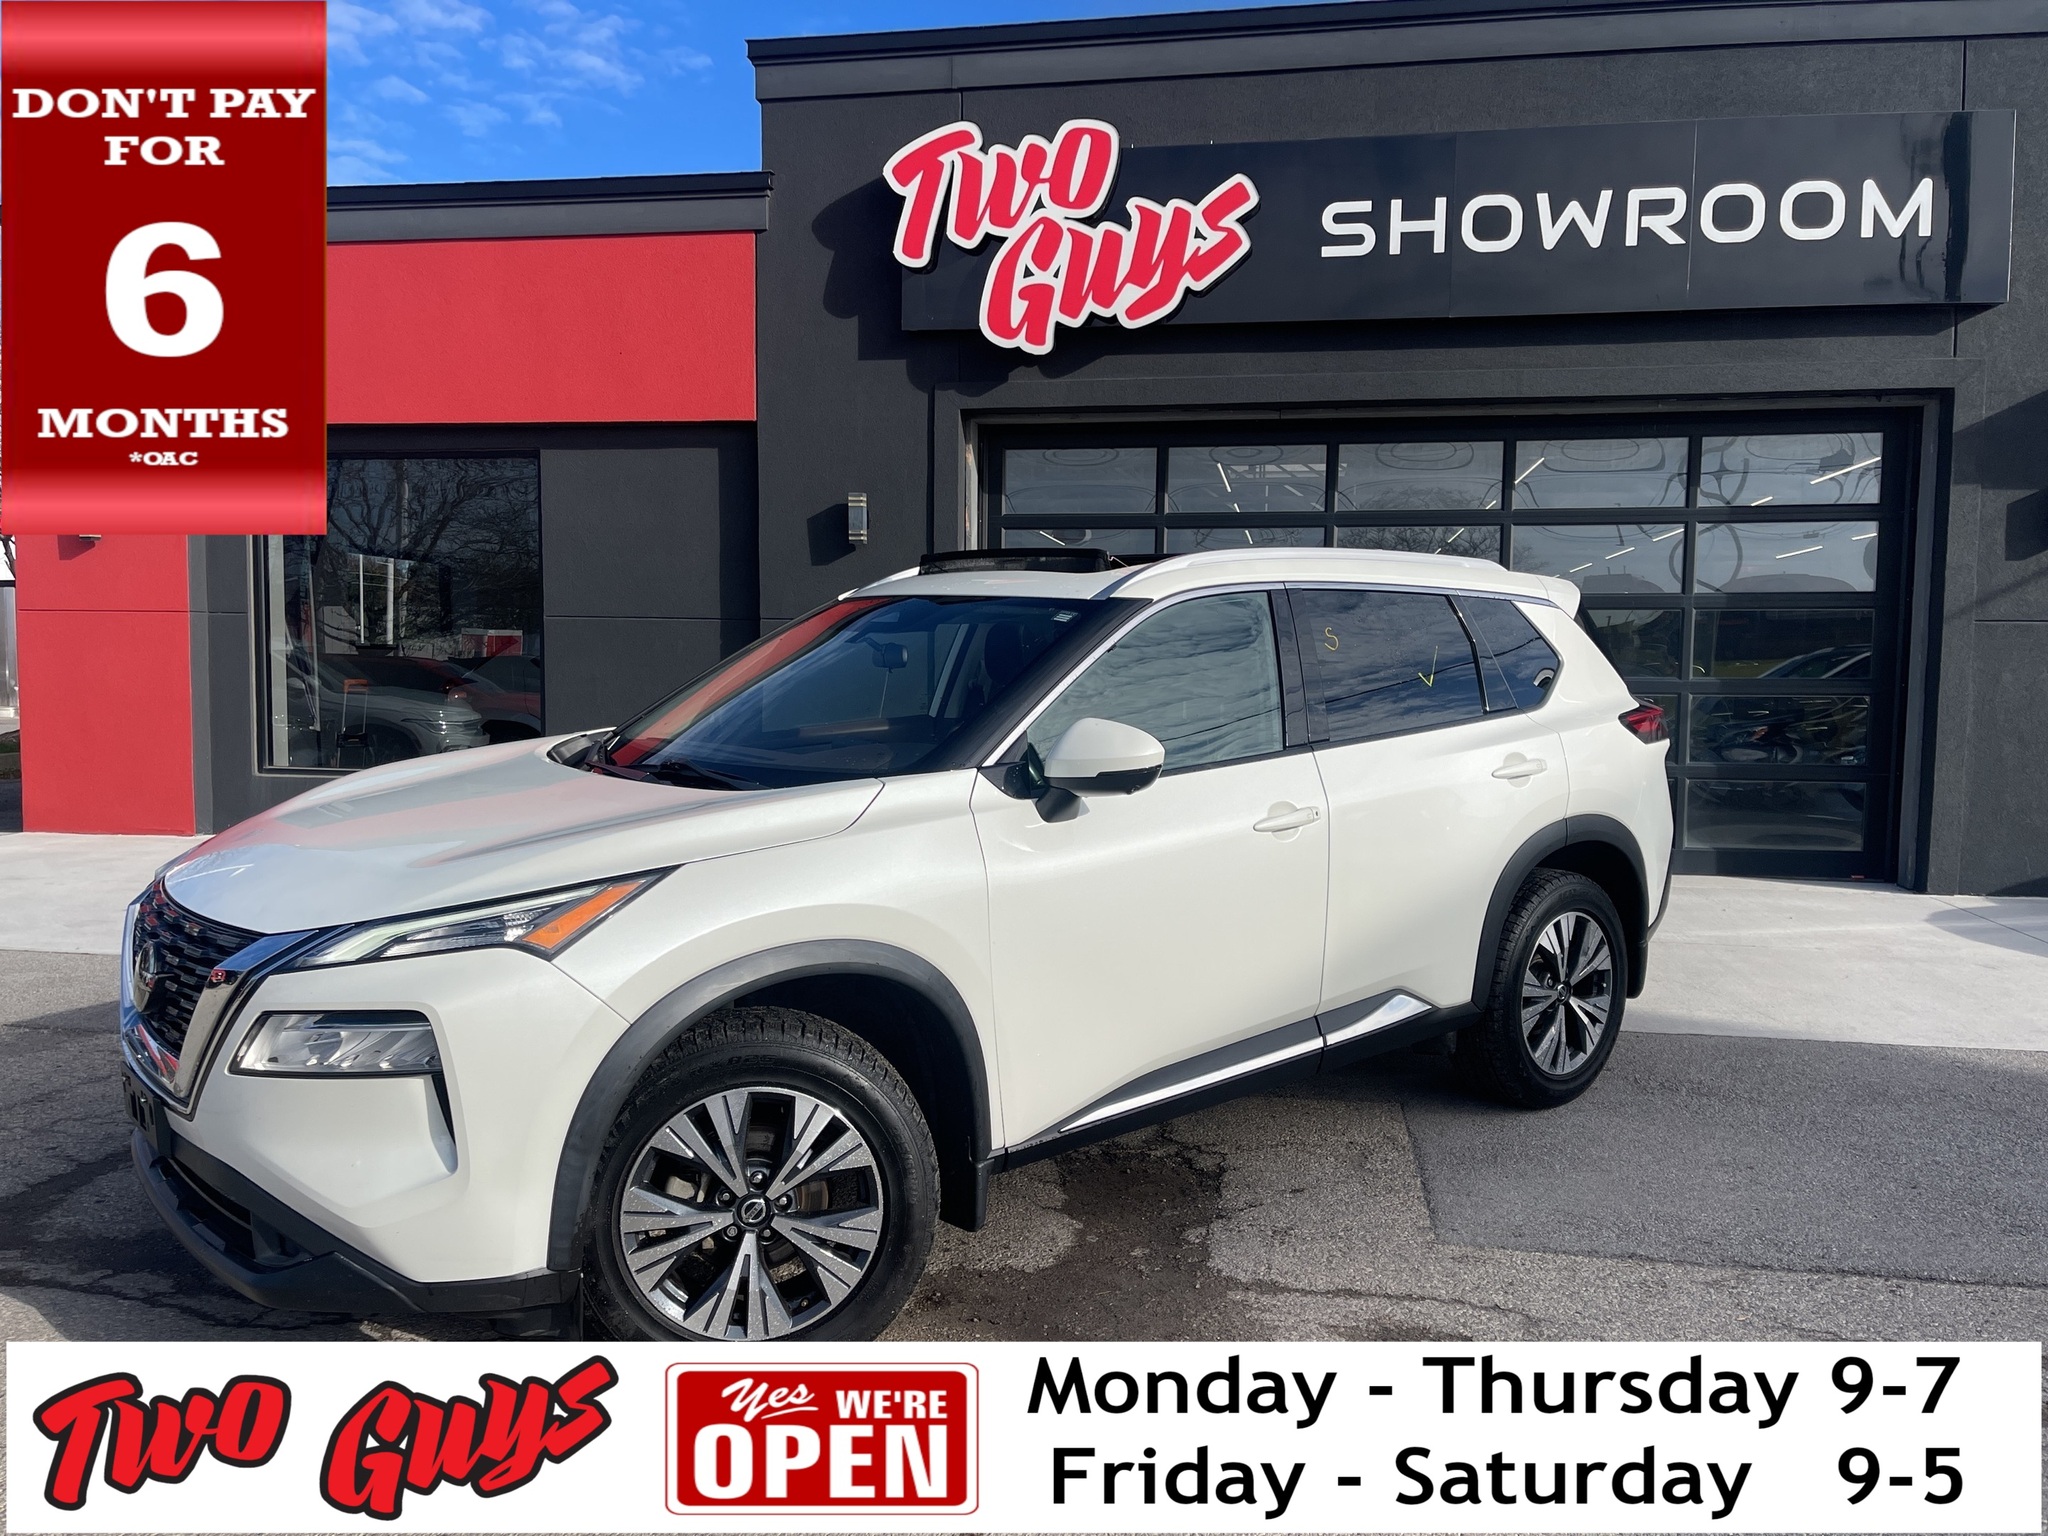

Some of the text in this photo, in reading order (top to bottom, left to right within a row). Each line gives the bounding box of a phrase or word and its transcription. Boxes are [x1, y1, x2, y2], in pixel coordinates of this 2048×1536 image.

[887, 121, 1117, 266] Two
[982, 175, 1258, 353] Guys
[1321, 175, 1935, 258] SHOWROOM
